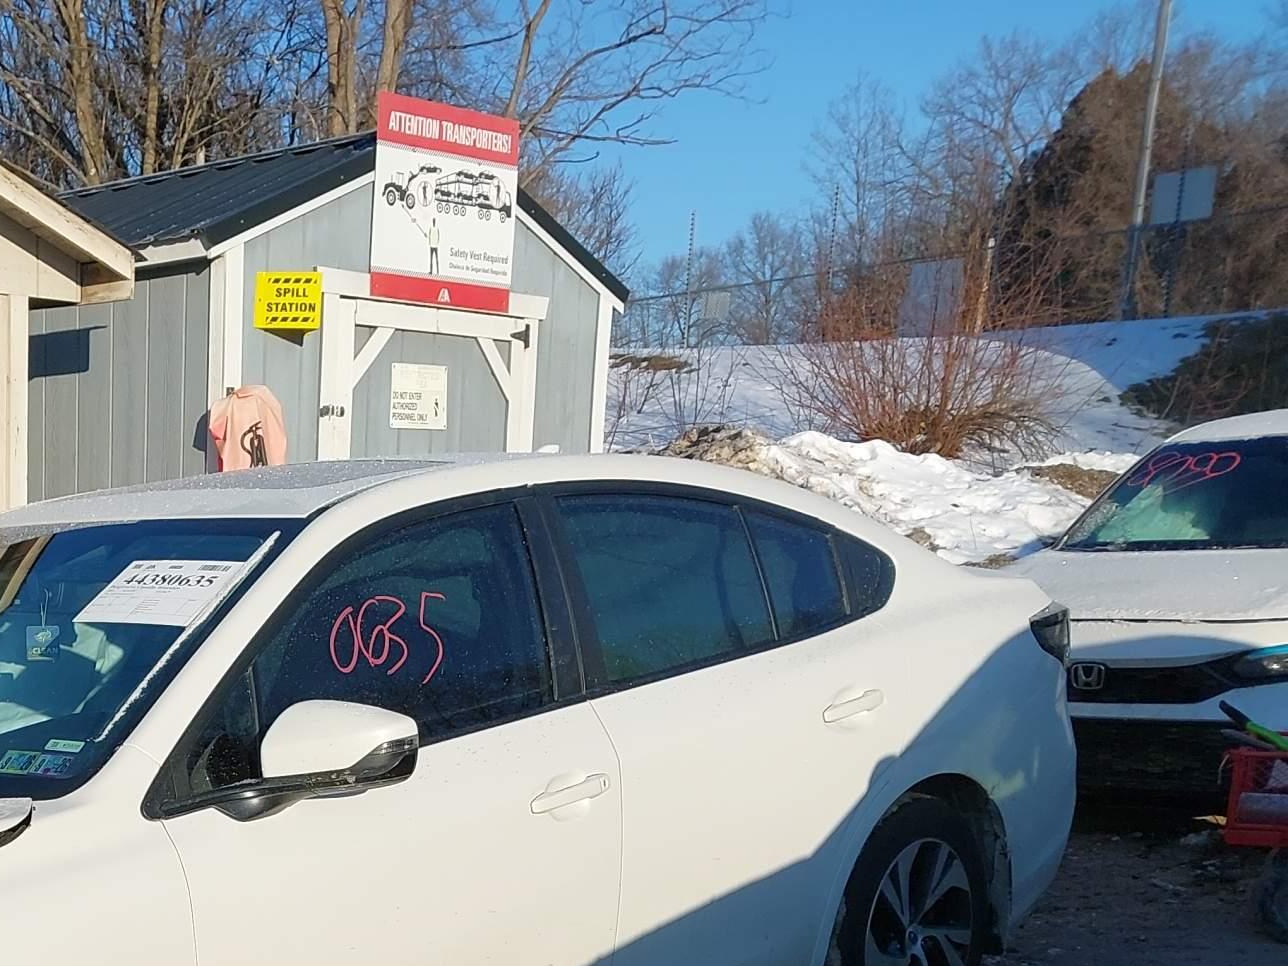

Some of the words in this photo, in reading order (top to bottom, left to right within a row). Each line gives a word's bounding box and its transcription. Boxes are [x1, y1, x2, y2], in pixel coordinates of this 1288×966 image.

[388, 110, 440, 139] ATTENTION
[441, 121, 512, 153] TRANSPORTERS!
[449, 247, 468, 260] Safety
[469, 251, 482, 261] Vest
[483, 252, 509, 265] Required
[275, 287, 309, 298] SPILL
[266, 302, 316, 313] STATION
[123, 573, 220, 588] 44380635
[329, 591, 446, 685] 0635
